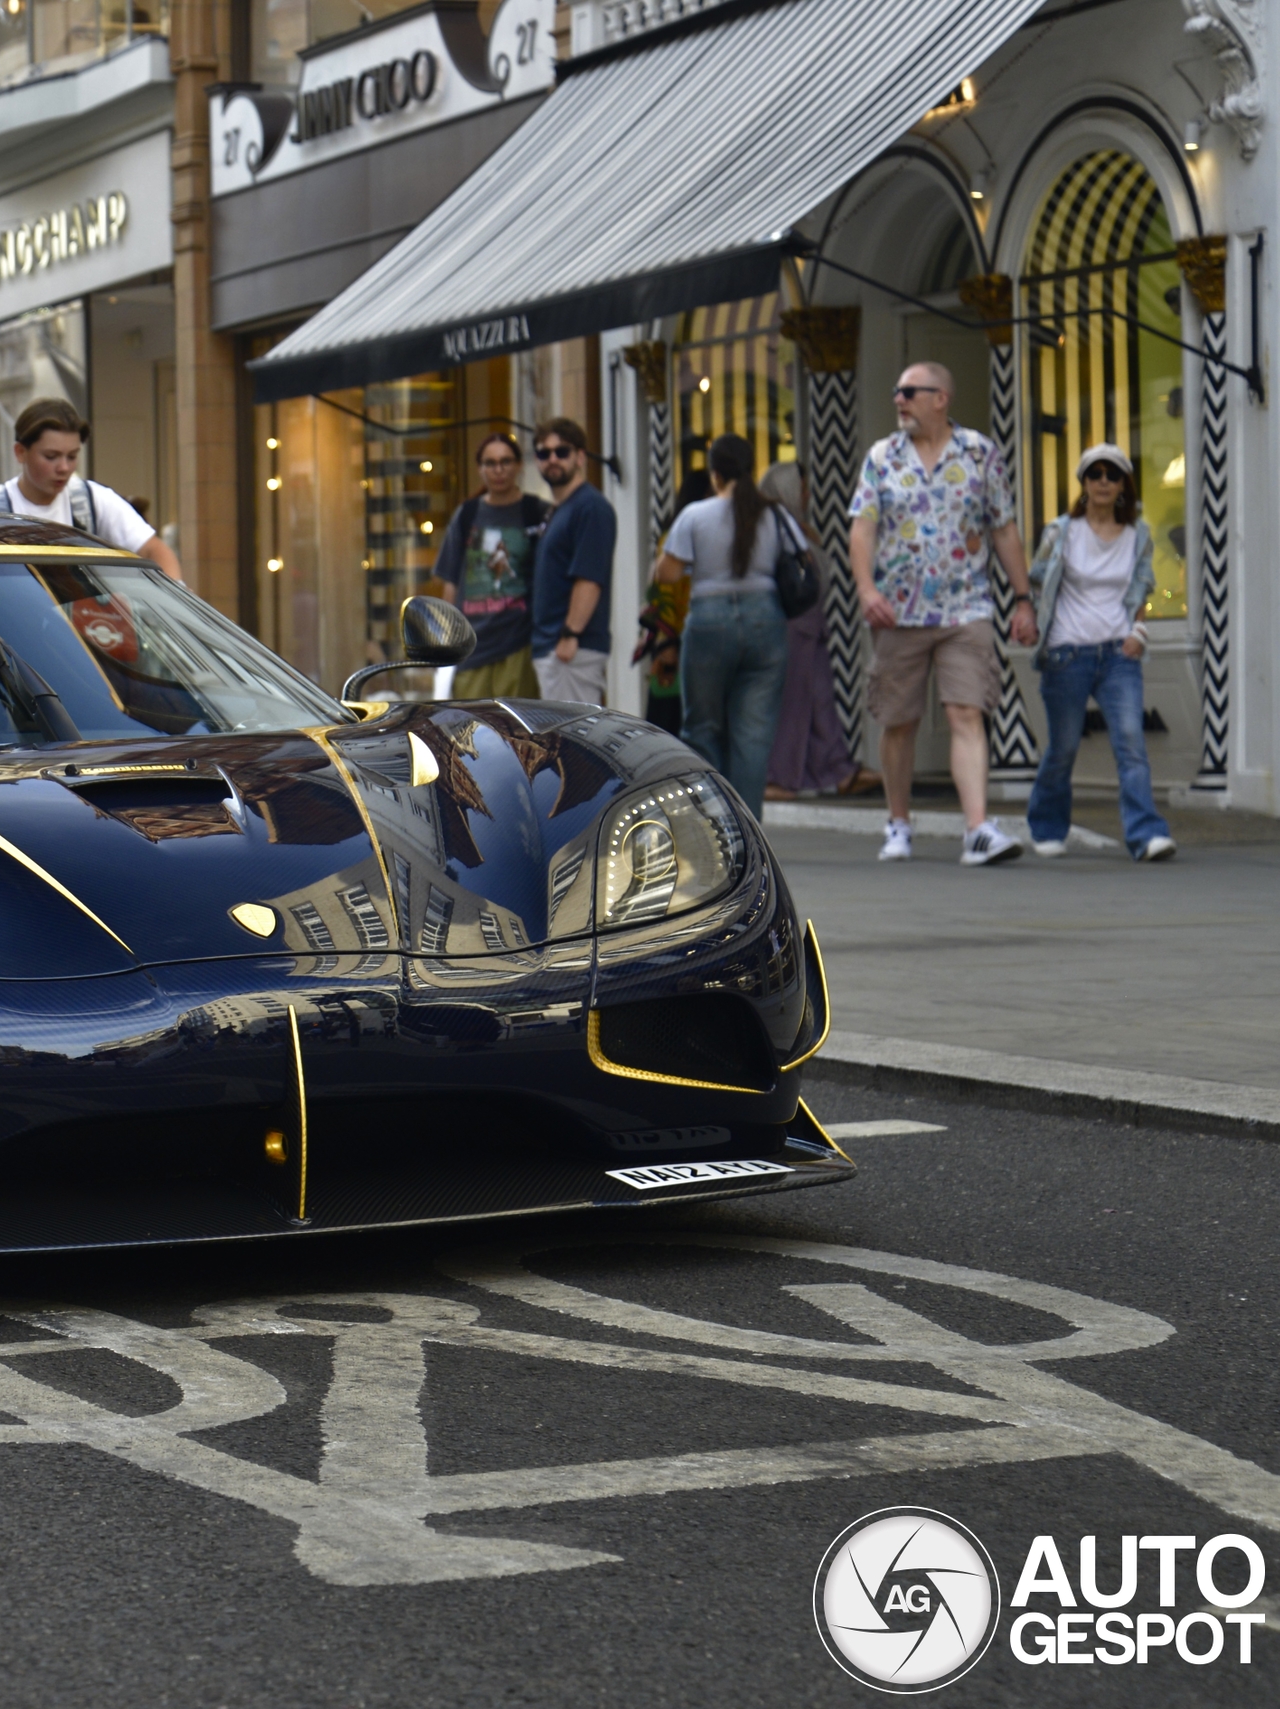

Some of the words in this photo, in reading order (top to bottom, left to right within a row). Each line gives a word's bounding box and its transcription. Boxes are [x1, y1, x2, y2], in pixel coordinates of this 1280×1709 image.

[516, 19, 537, 65] 27
[289, 75, 356, 144] JIMMY
[357, 50, 437, 118] CHOO
[223, 128, 239, 166] 27
[441, 313, 531, 362] AQUAZZURA
[706, 1160, 778, 1176] AYA
